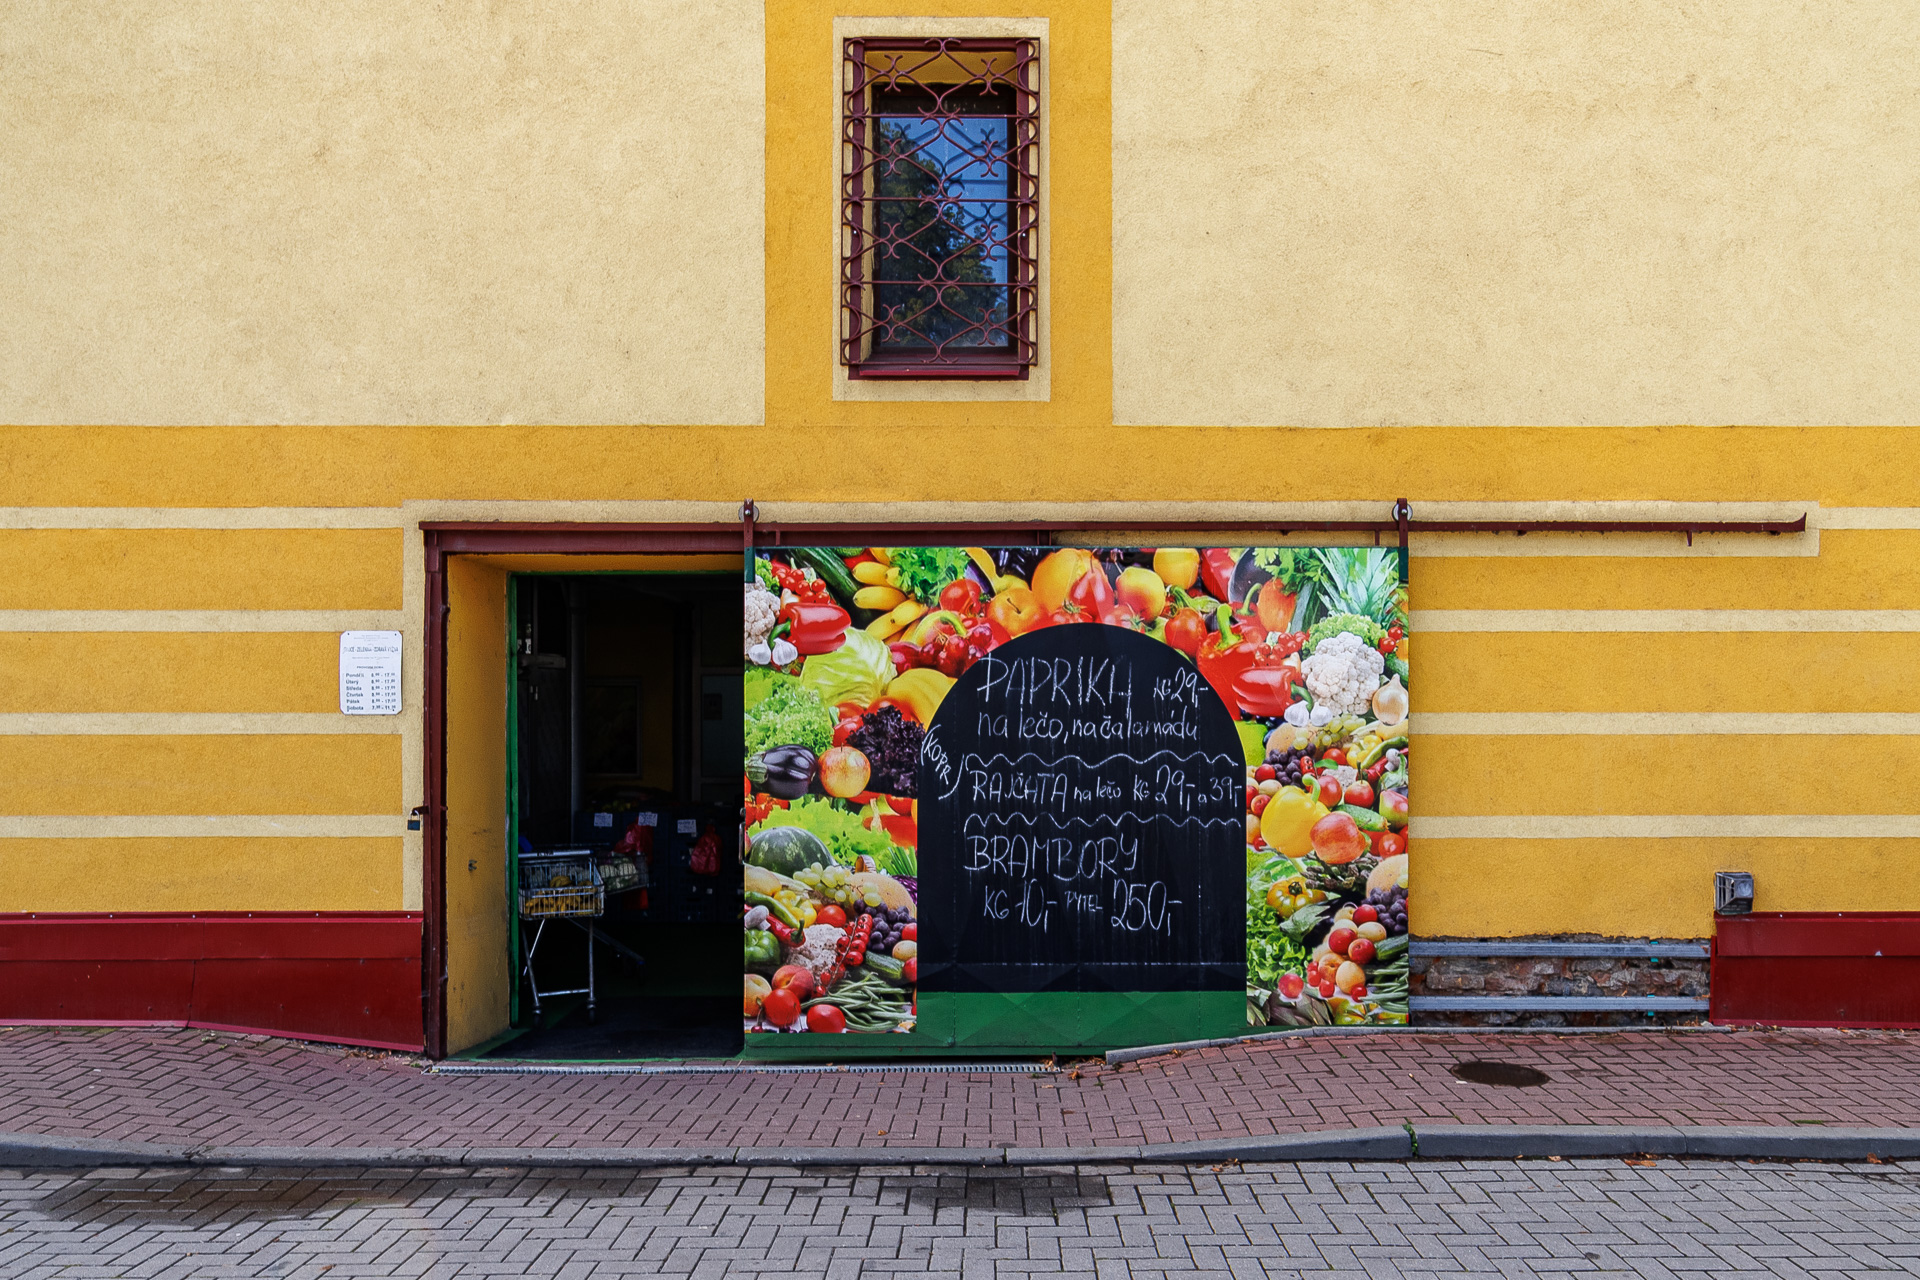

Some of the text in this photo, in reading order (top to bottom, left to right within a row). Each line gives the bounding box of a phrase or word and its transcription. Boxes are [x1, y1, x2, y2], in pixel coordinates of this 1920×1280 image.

[977, 652, 1132, 714] PAPRIKA
[1153, 675, 1172, 701] KG
[977, 710, 1008, 739] na
[1018, 707, 1069, 744] lečo,
[969, 769, 1067, 812] RAJČATA
[1074, 785, 1091, 802] na
[1096, 779, 1122, 799] lečo
[1133, 774, 1150, 802] KG
[1198, 792, 1208, 804] a
[963, 833, 1138, 881] BRAMBORY
[983, 885, 1010, 920] KG
[1064, 890, 1104, 912] PYTEL
